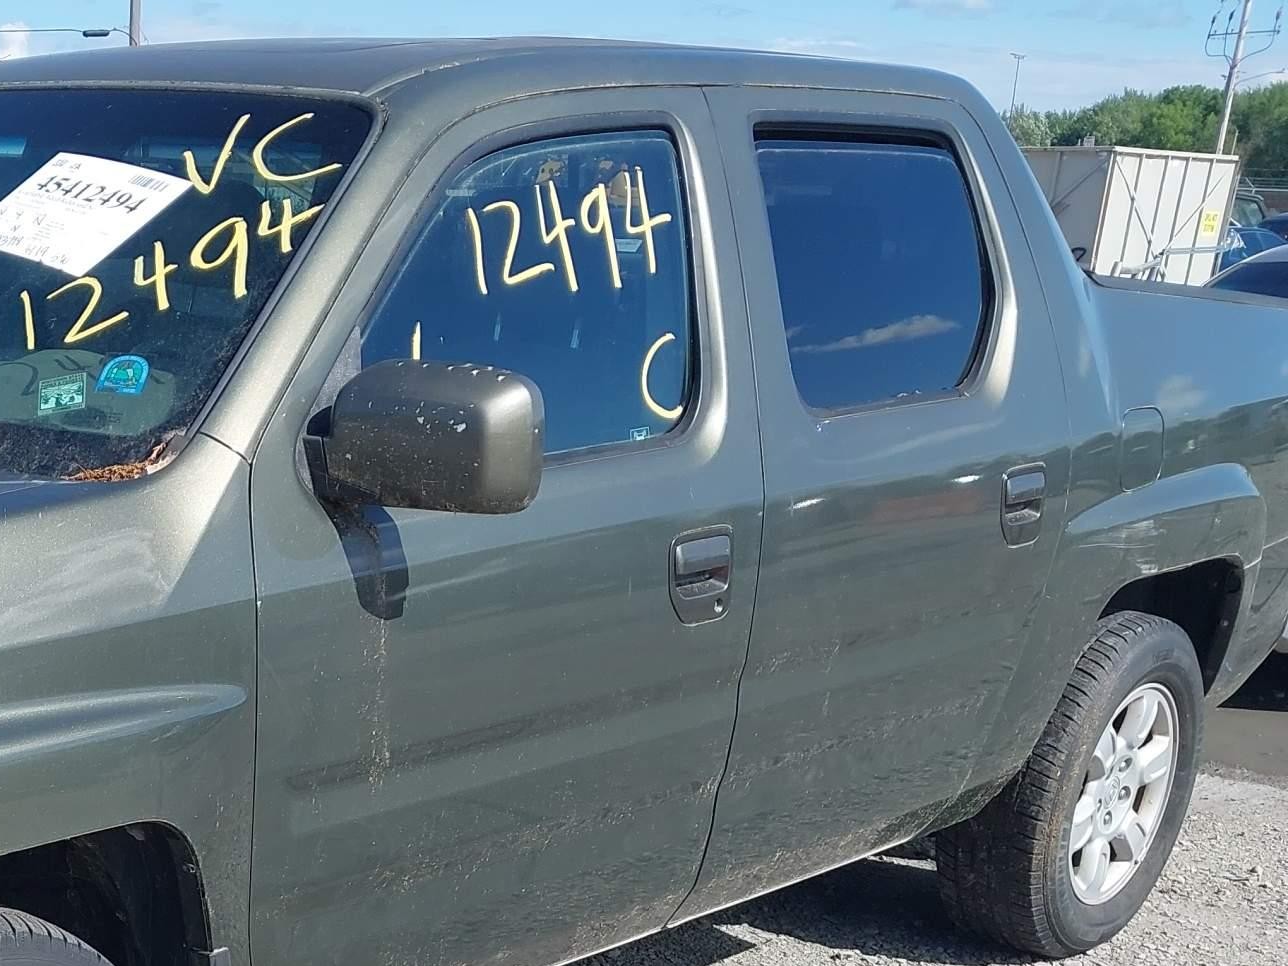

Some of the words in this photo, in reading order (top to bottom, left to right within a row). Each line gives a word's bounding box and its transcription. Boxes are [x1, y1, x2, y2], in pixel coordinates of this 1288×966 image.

[36, 175, 147, 214] 45412494
[183, 112, 343, 194] VC
[20, 198, 326, 350] 12494
[467, 166, 672, 294] 12494
